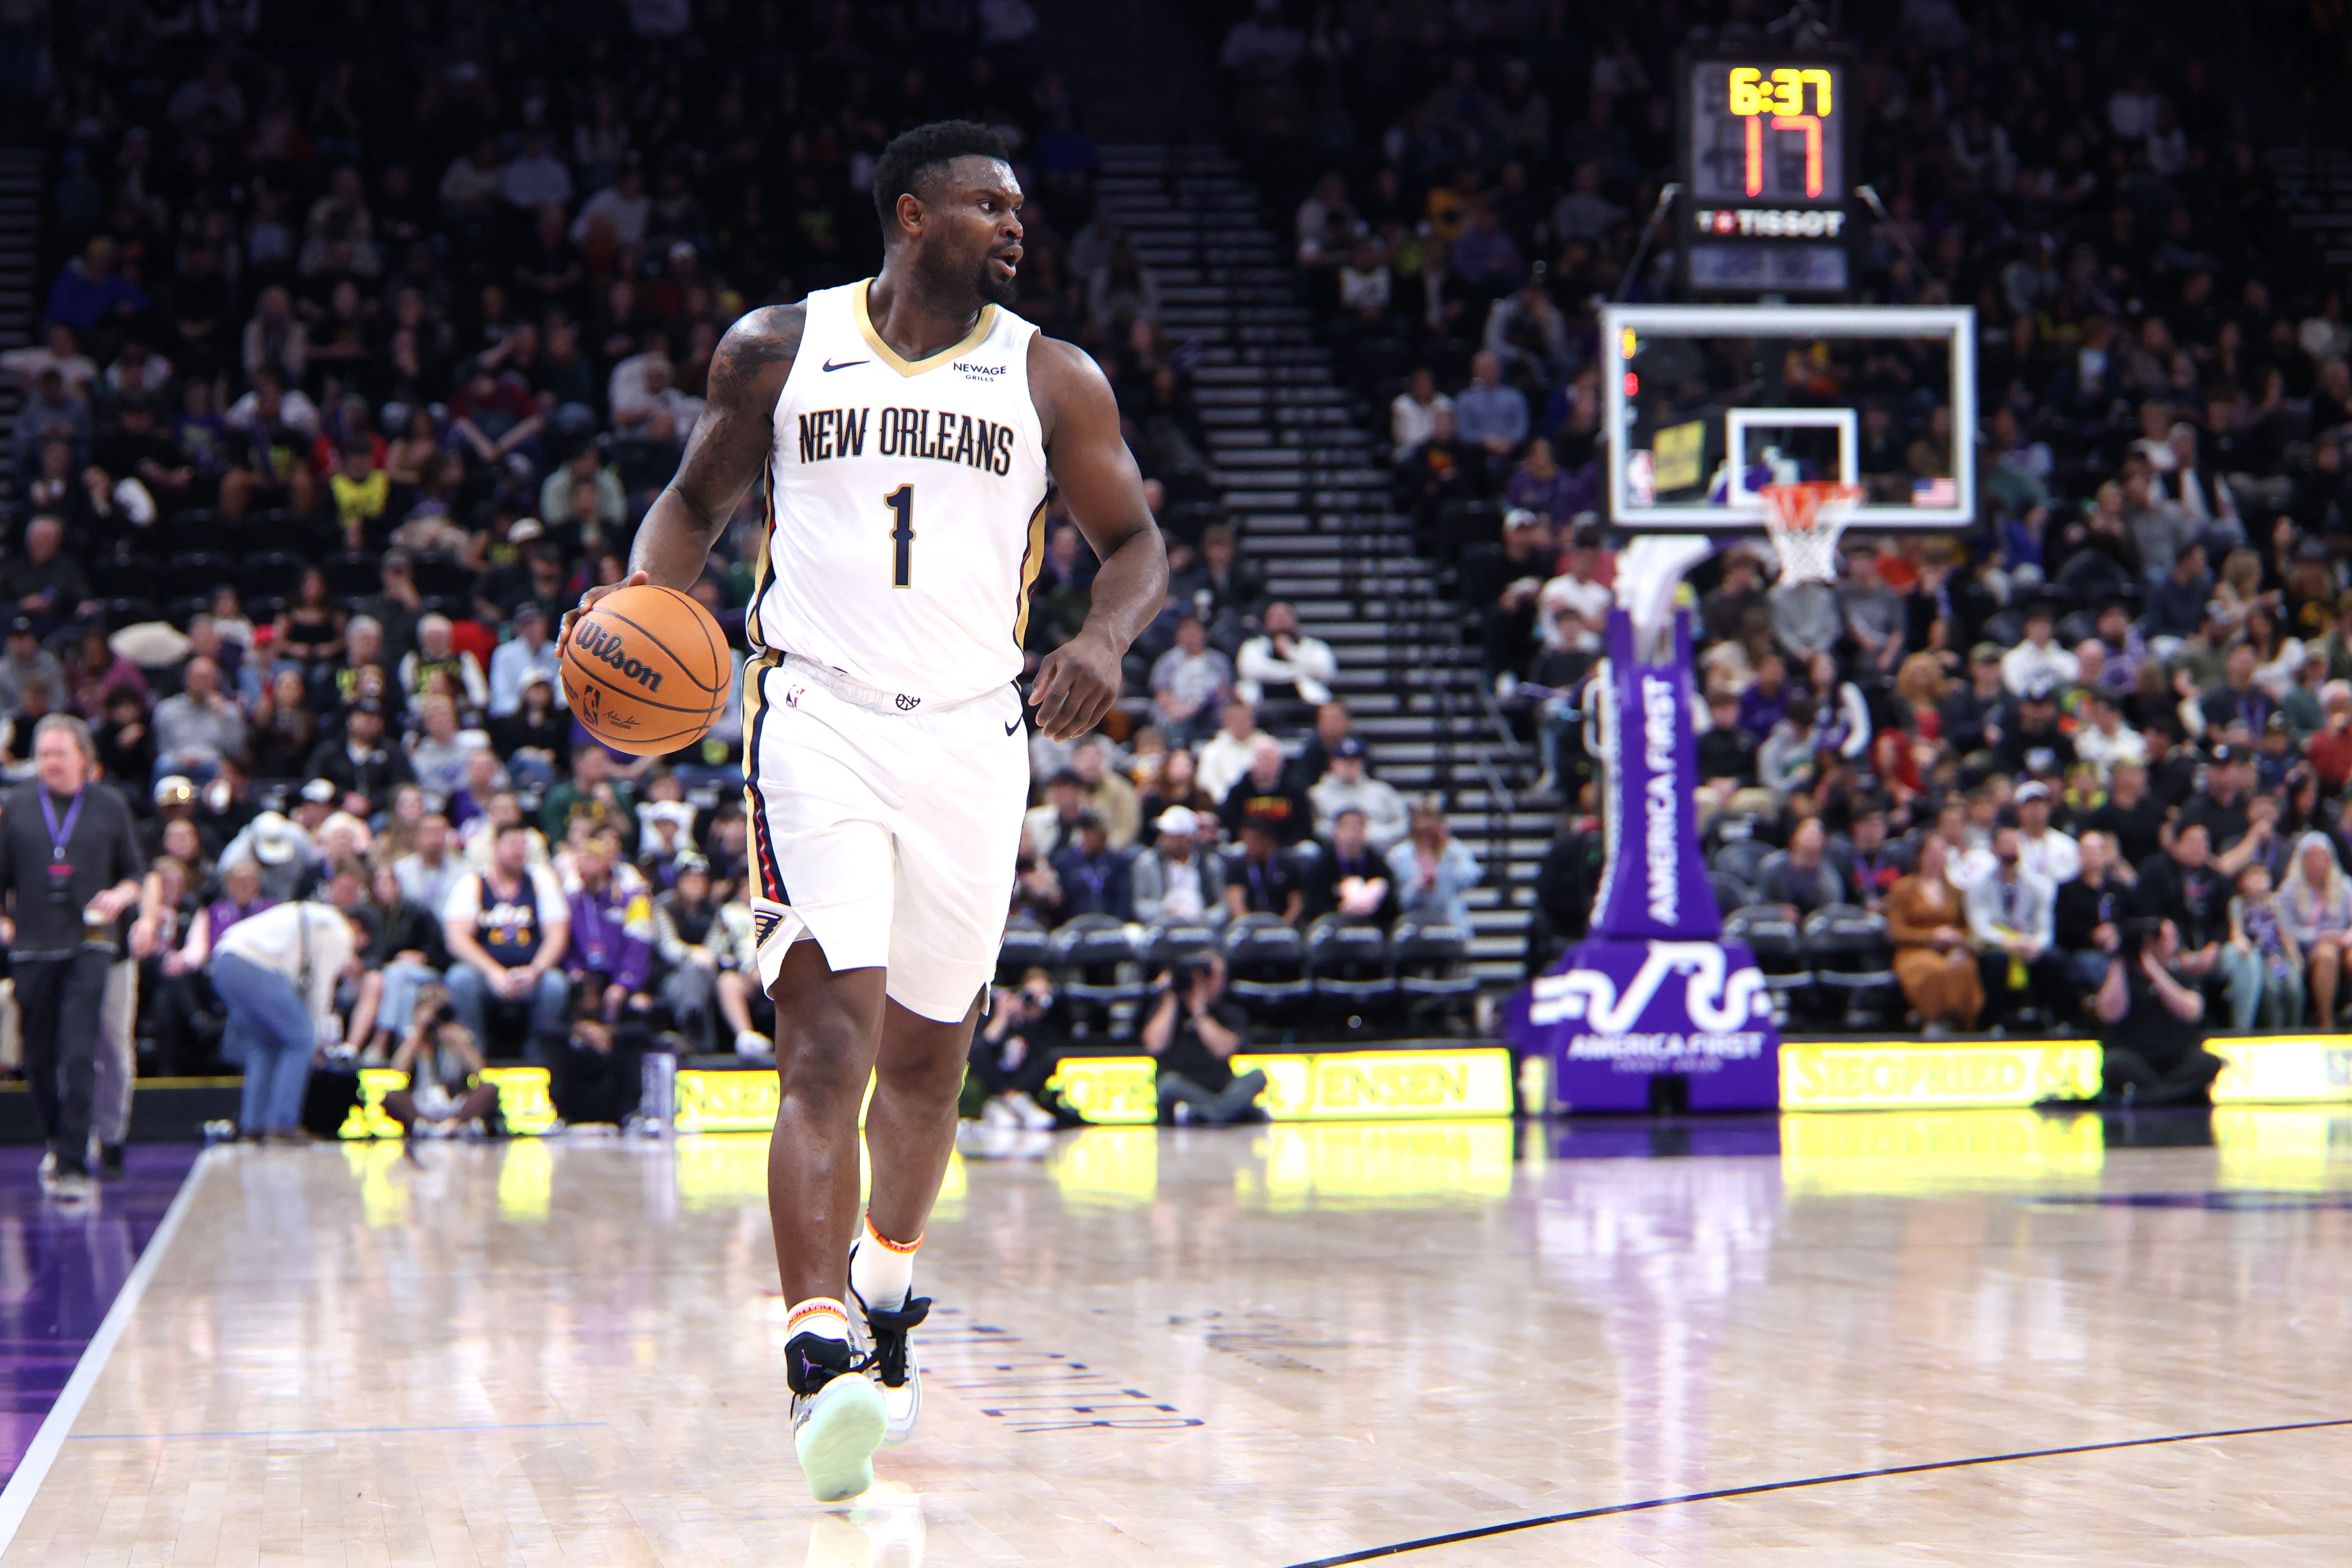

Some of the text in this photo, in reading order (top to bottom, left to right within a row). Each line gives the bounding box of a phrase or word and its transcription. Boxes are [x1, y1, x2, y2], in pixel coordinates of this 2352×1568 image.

[1729, 68, 1831, 117] 6:37
[1745, 115, 1822, 198] 17
[1736, 209, 1846, 237] TISSOT
[953, 362, 1006, 375] NEWAGE
[798, 407, 1014, 477] NEW ORLEANS
[884, 483, 916, 589] 1
[575, 617, 664, 693] Wilson
[1642, 674, 1680, 927] AMERICA FIRST
